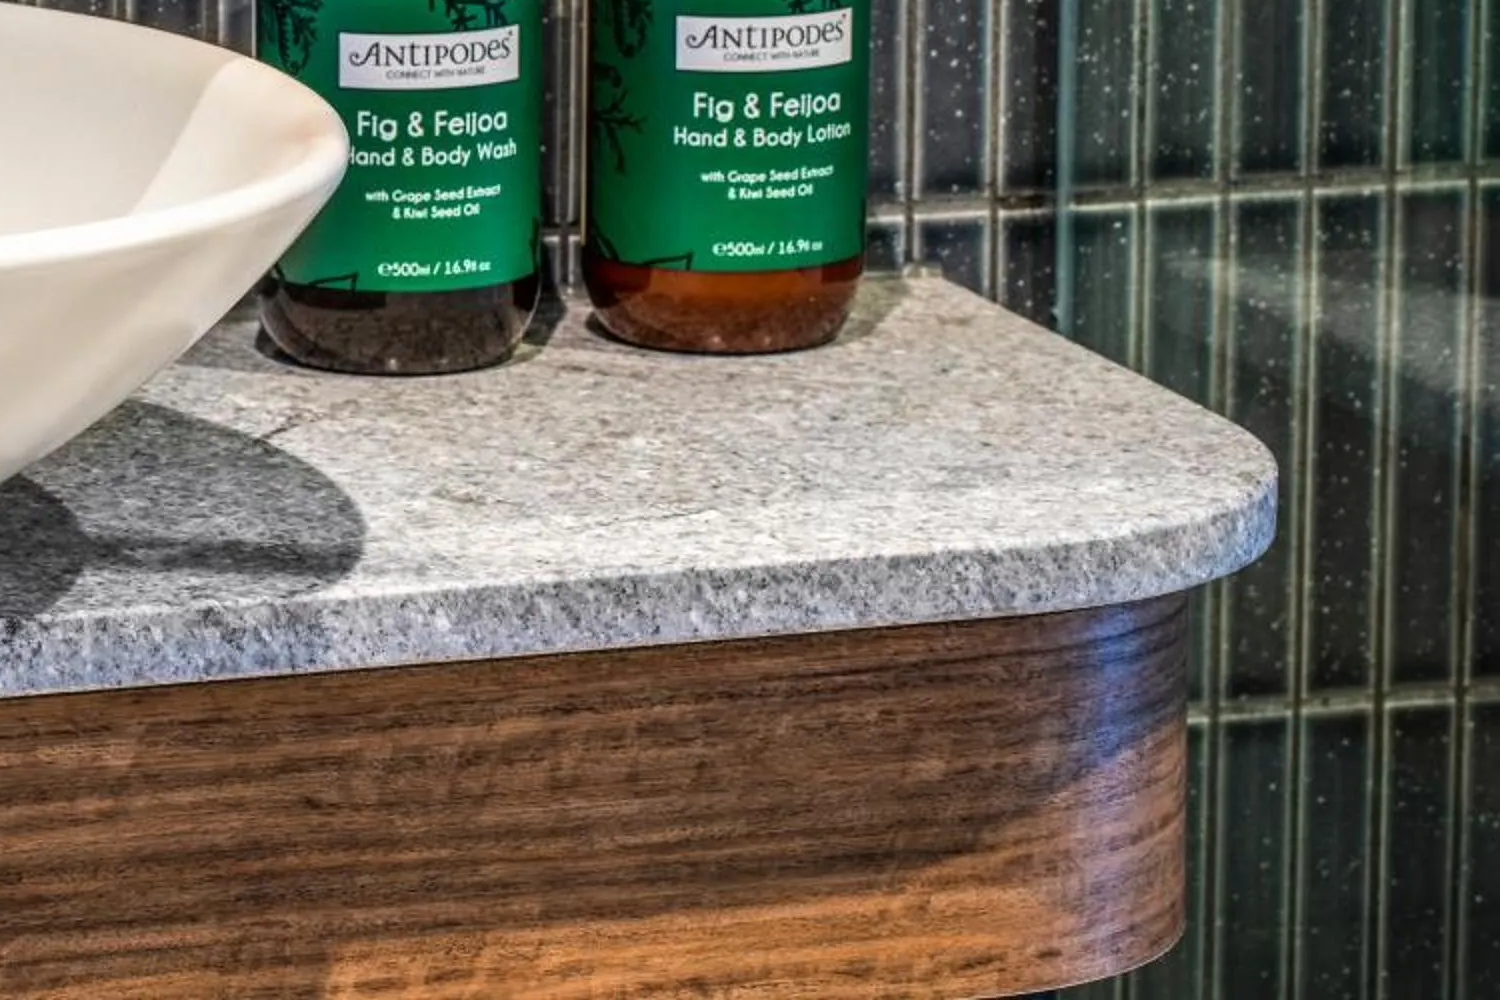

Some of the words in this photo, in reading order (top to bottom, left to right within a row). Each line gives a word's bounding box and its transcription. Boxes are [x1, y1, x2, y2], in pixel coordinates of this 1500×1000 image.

[693, 91, 734, 123] Fig
[744, 92, 760, 119] &
[770, 91, 841, 118] Feijoa
[357, 110, 398, 142] Fig
[407, 111, 424, 137] &
[434, 110, 507, 137] Feijoa
[674, 125, 728, 147] Hand
[733, 127, 747, 147] &
[753, 125, 802, 149] Body
[807, 121, 851, 143] Lotion
[402, 147, 415, 167] &
[421, 144, 471, 167] Body
[476, 137, 517, 161] Wash
[701, 170, 725, 183] with
[727, 169, 767, 187] Grape
[769, 168, 799, 181] Seed
[365, 189, 389, 202] with
[392, 188, 431, 205] Grape
[434, 187, 464, 201] Seed
[766, 185, 796, 199] Seed
[797, 183, 814, 197] Oil
[430, 204, 461, 218] Seed
[463, 202, 480, 216] Oil
